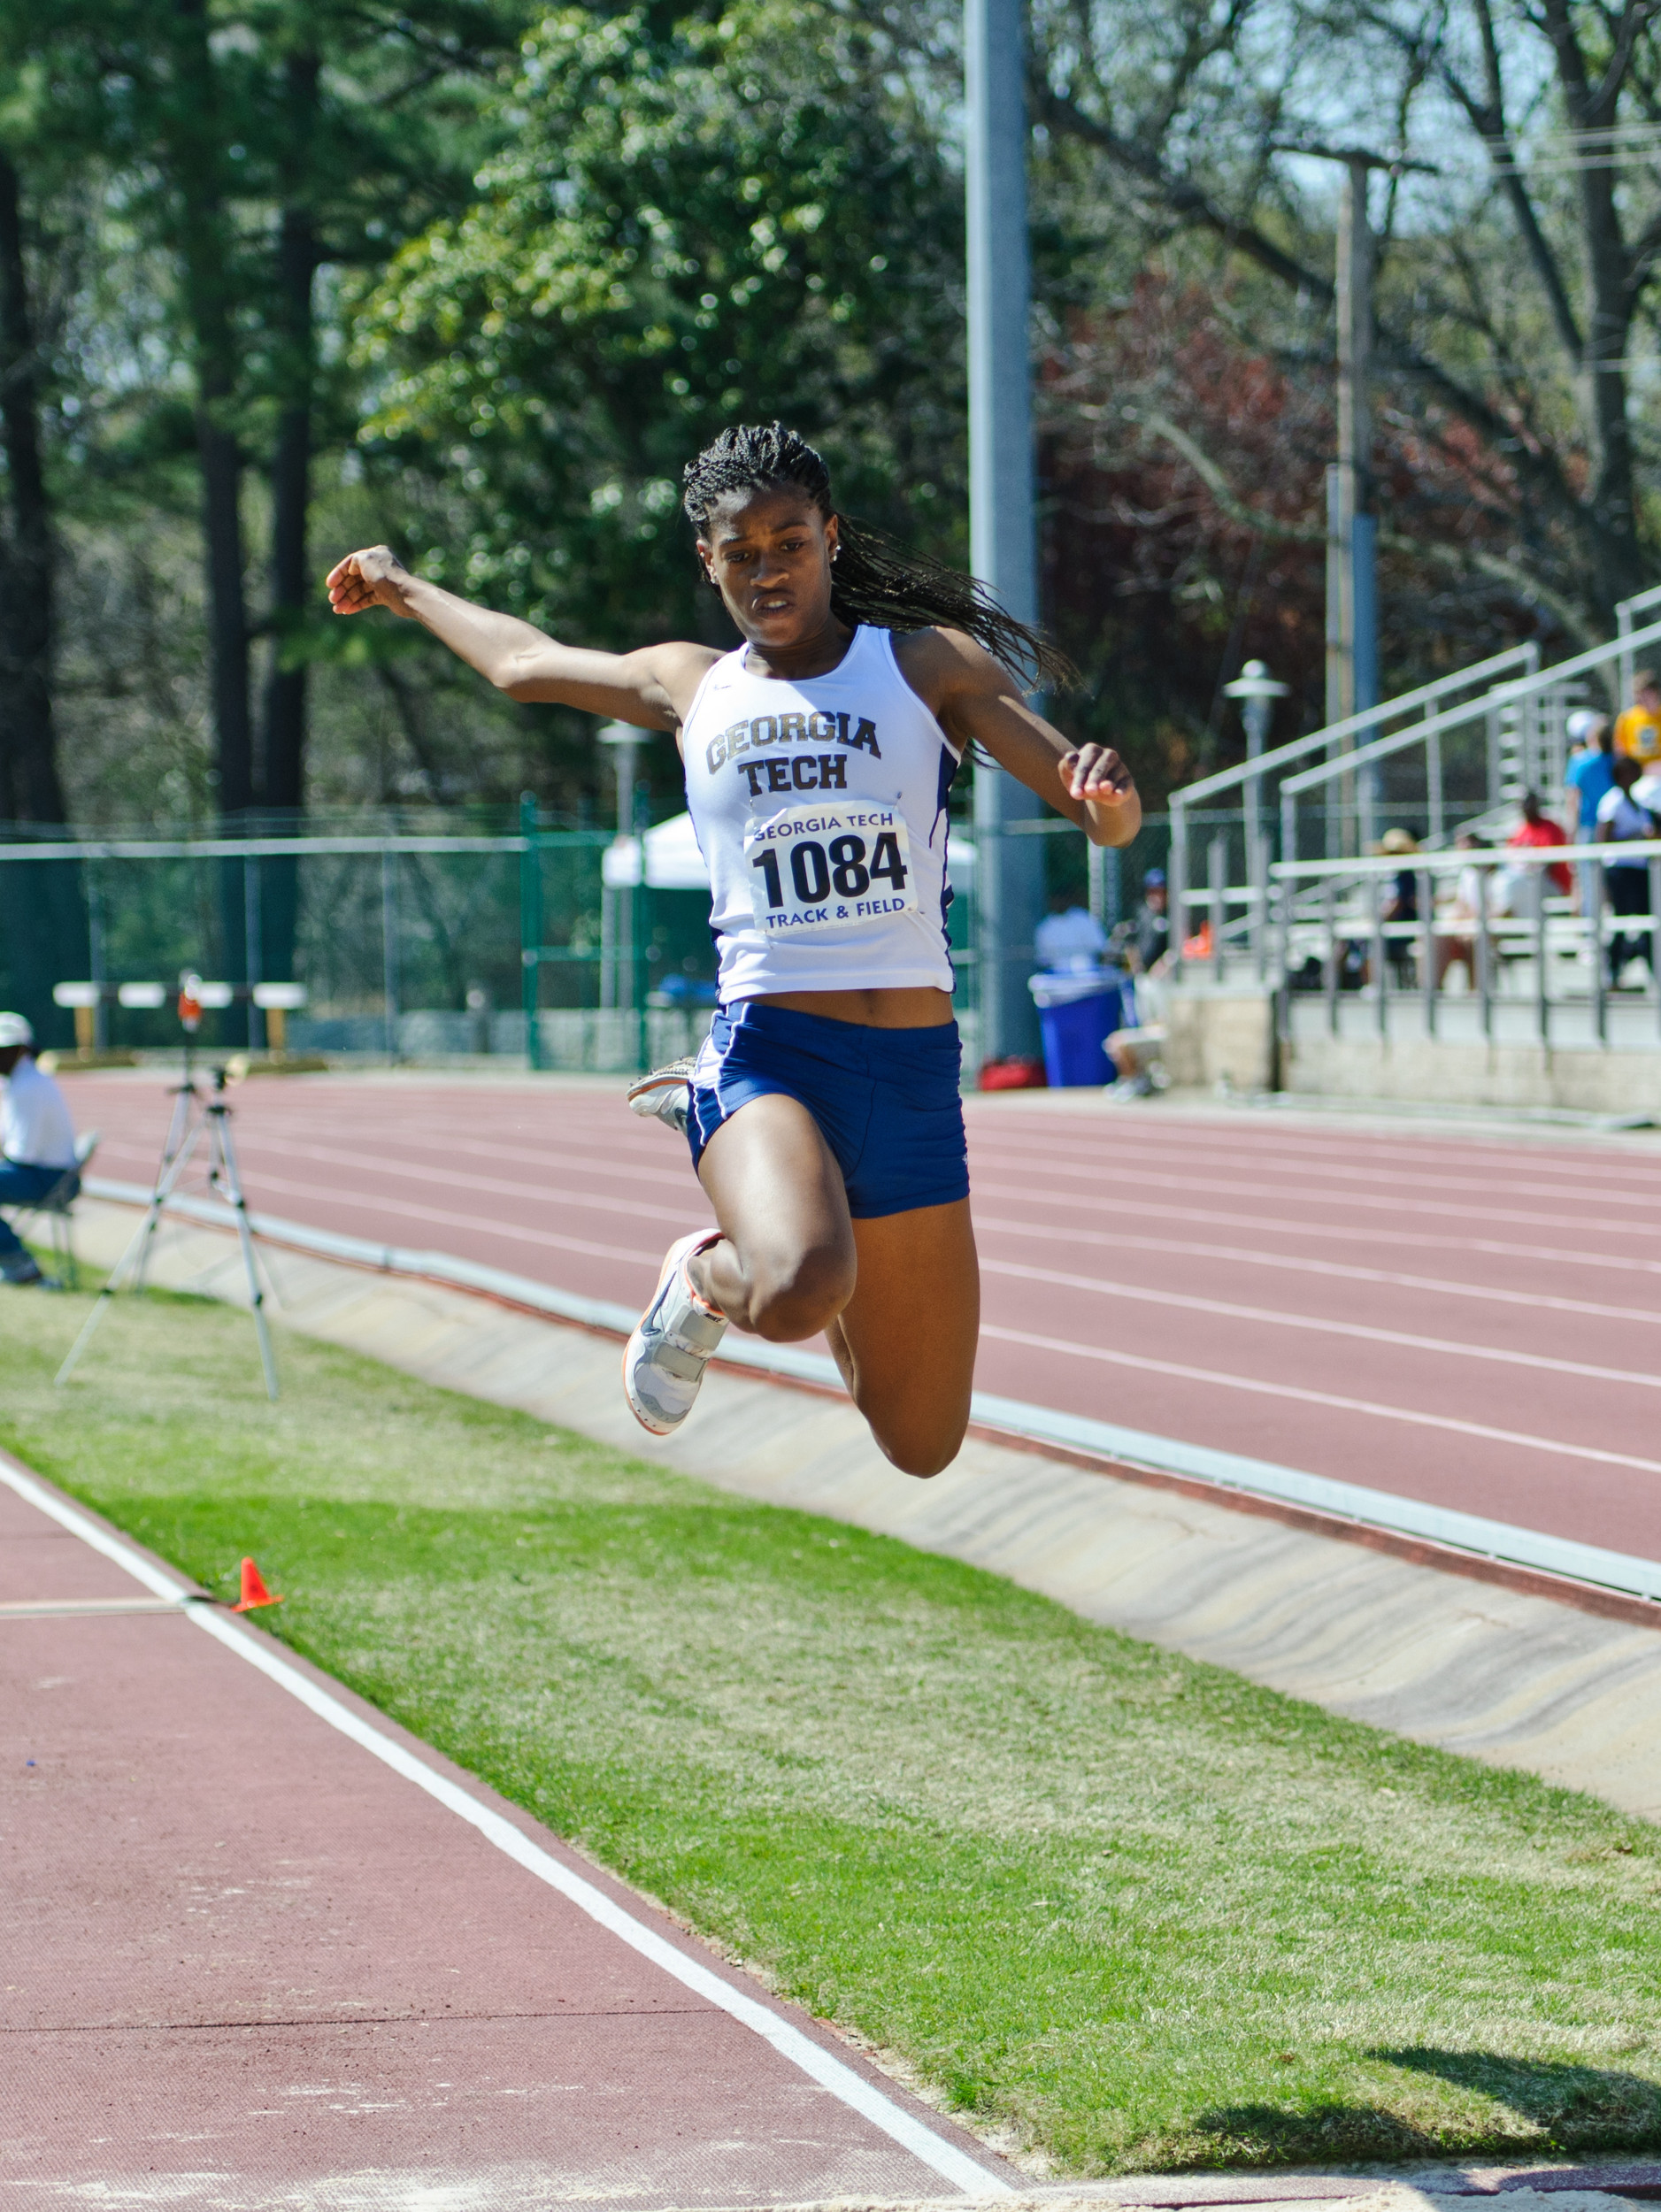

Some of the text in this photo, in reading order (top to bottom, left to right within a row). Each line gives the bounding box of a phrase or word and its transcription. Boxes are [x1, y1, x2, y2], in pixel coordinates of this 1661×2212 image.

[706, 710, 881, 775] GEORGIA
[737, 754, 848, 797] TECH
[754, 812, 894, 841] GEORGIA TECH
[752, 832, 908, 909] 1084
[765, 908, 828, 929] TRACK
[835, 905, 849, 919] &
[856, 897, 905, 917] FIELD
